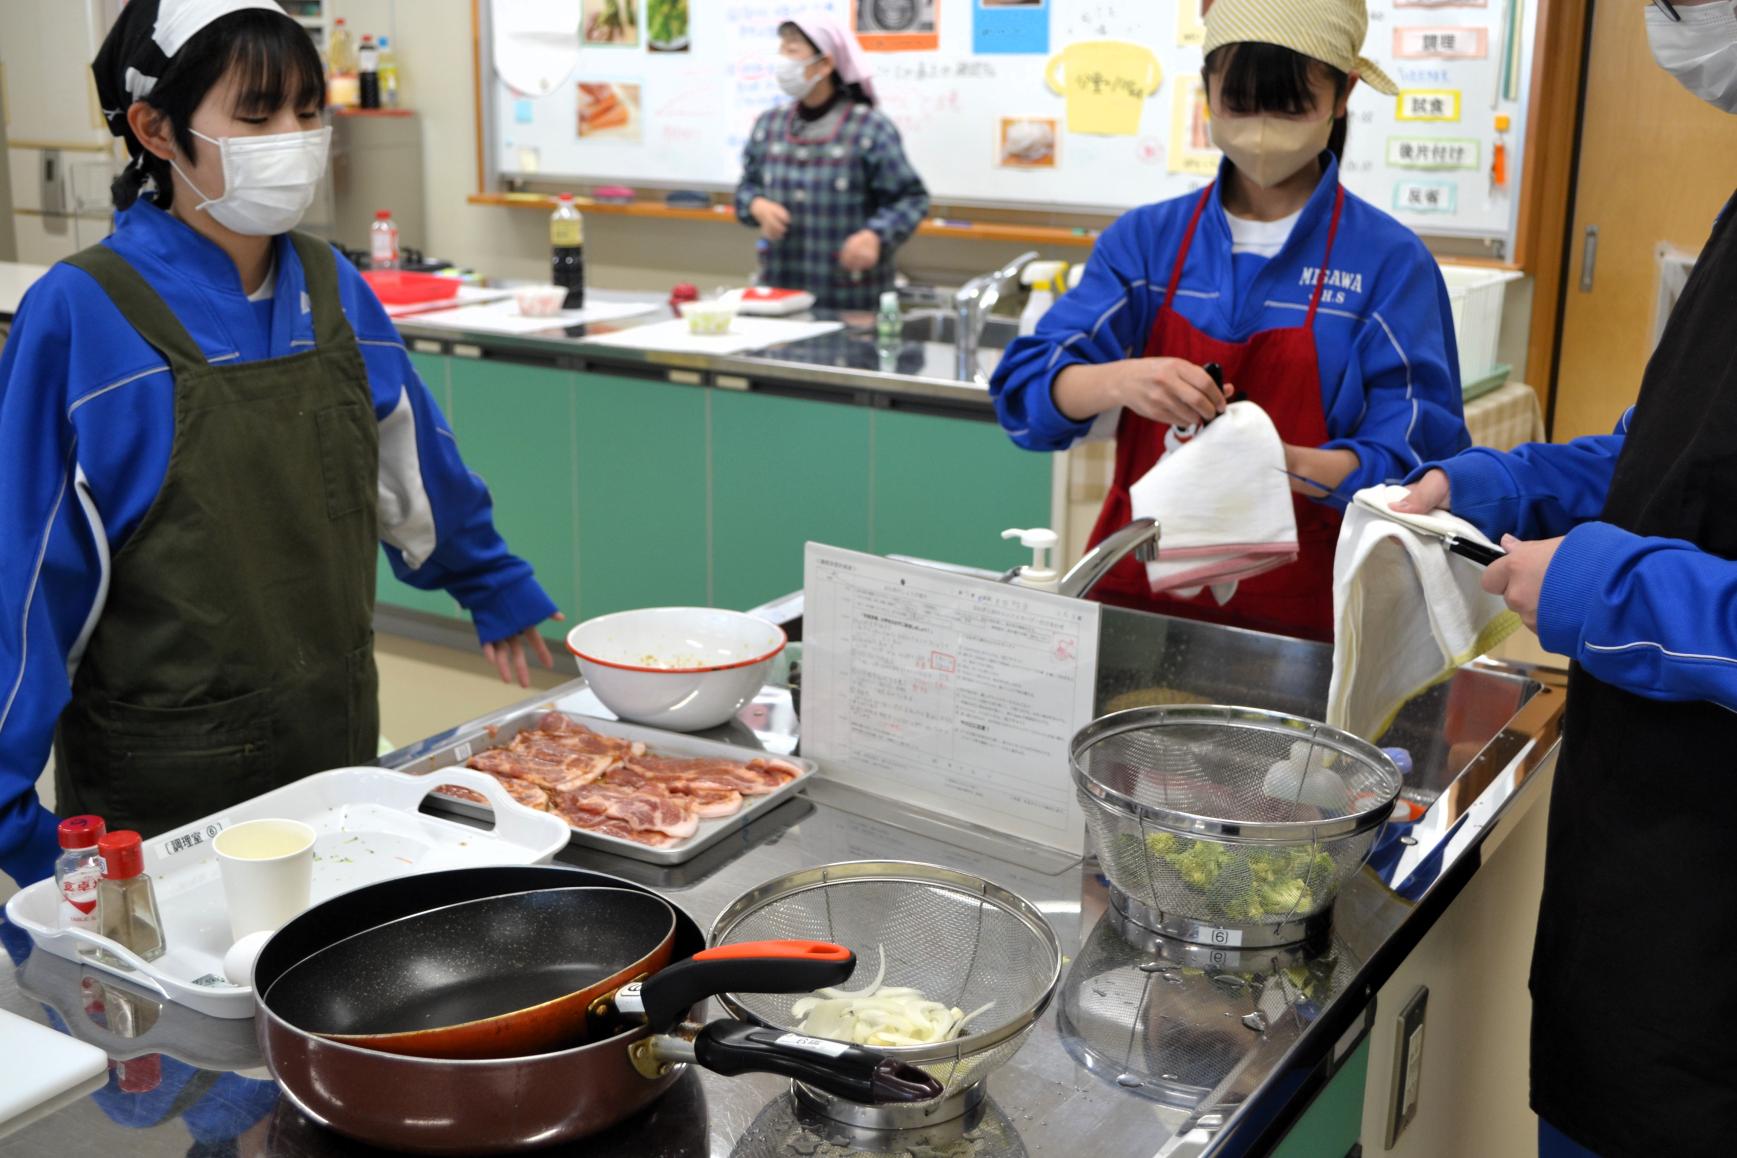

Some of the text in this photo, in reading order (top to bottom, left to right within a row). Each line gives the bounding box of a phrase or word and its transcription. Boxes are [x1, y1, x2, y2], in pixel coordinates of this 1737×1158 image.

[1411, 97, 1444, 115] 試食
[1399, 142, 1464, 162] 後片付け
[1408, 187, 1440, 205] 反省
